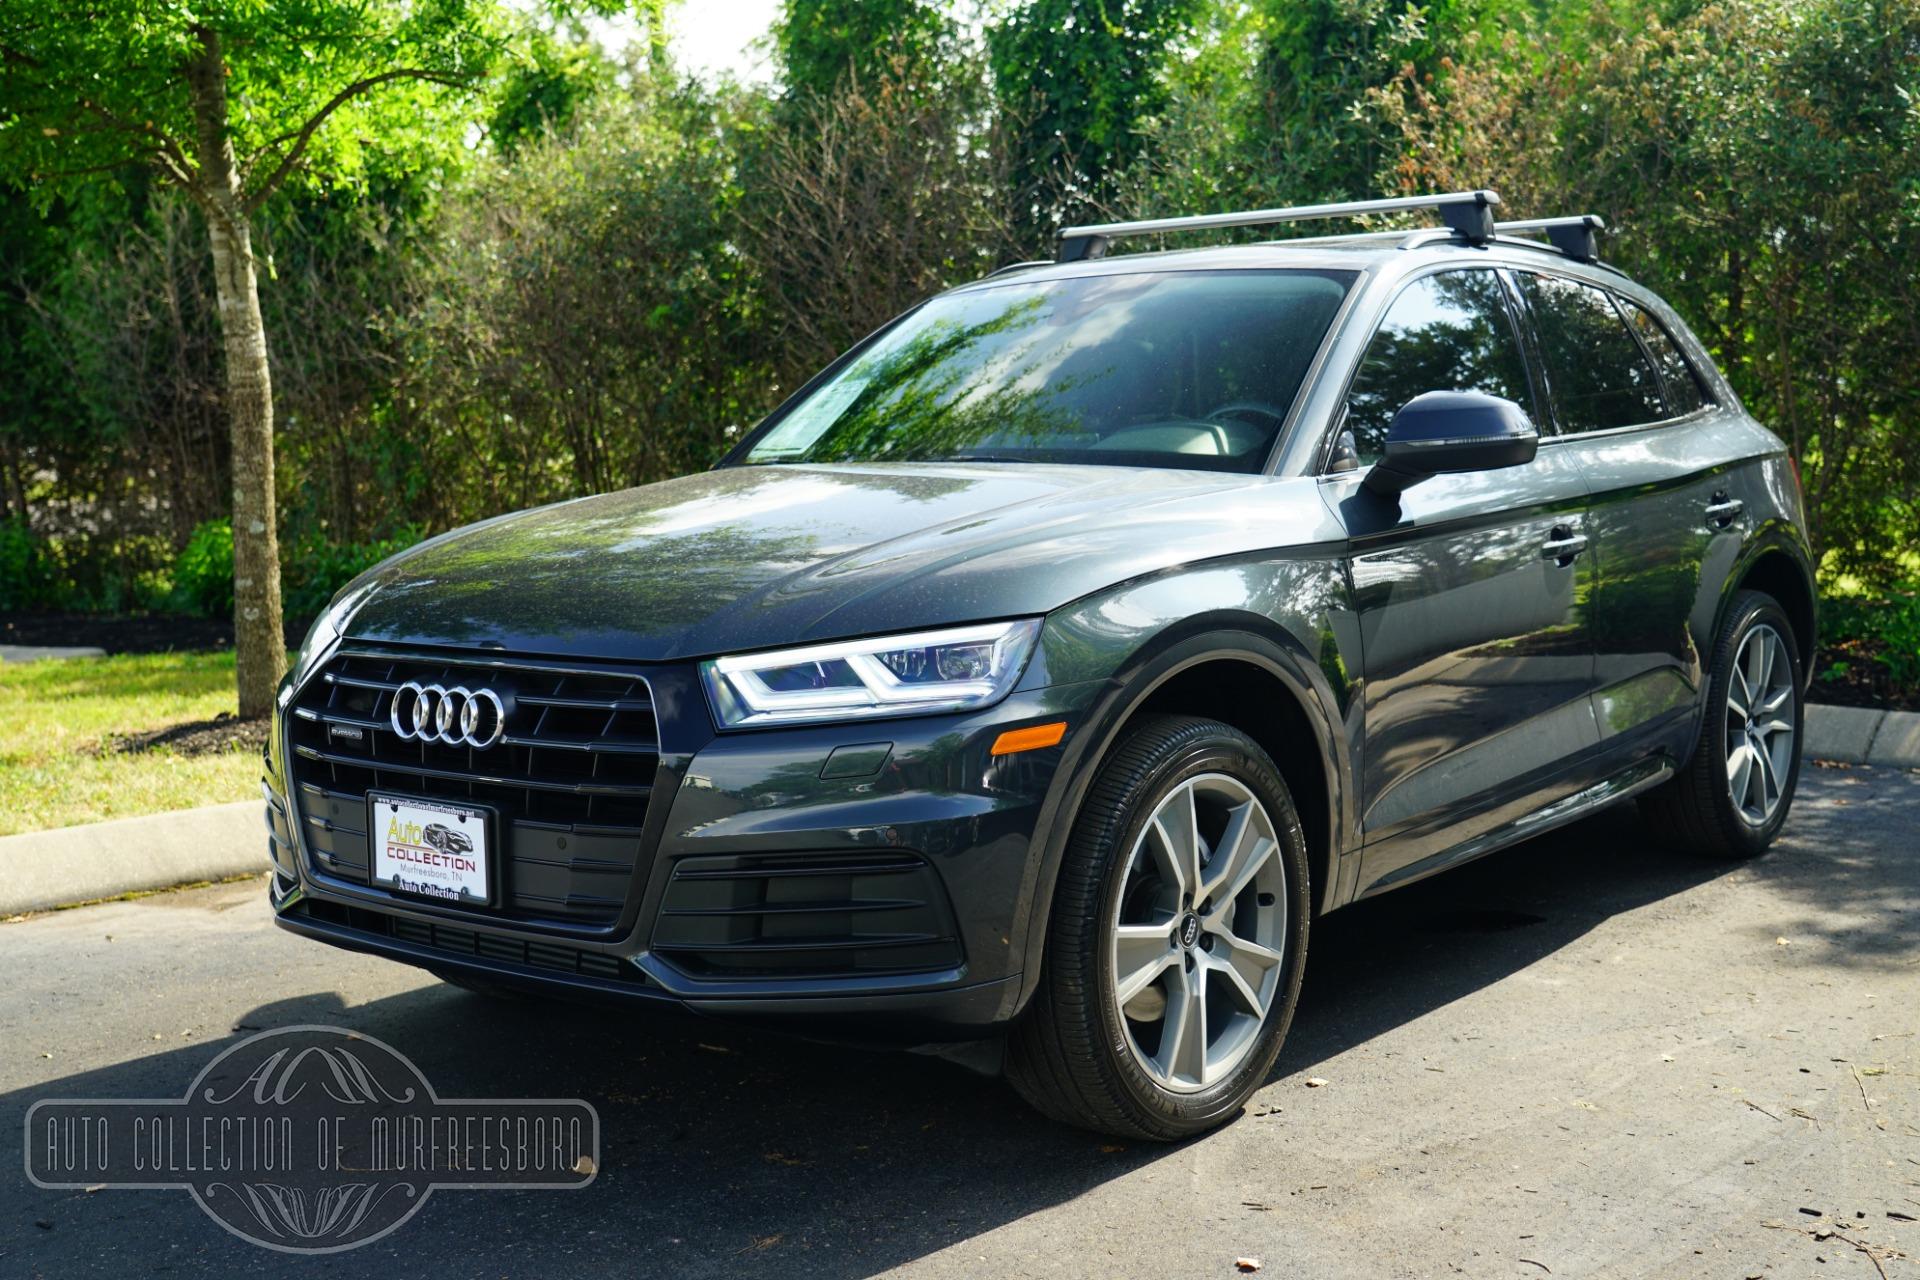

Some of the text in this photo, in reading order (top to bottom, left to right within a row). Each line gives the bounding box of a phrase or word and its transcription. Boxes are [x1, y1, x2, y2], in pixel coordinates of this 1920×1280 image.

[387, 815, 422, 845] Auto
[387, 847, 476, 872] COLLECTION
[400, 863, 463, 882] Murfreesboro, TN
[398, 879, 459, 900] Auto Collection
